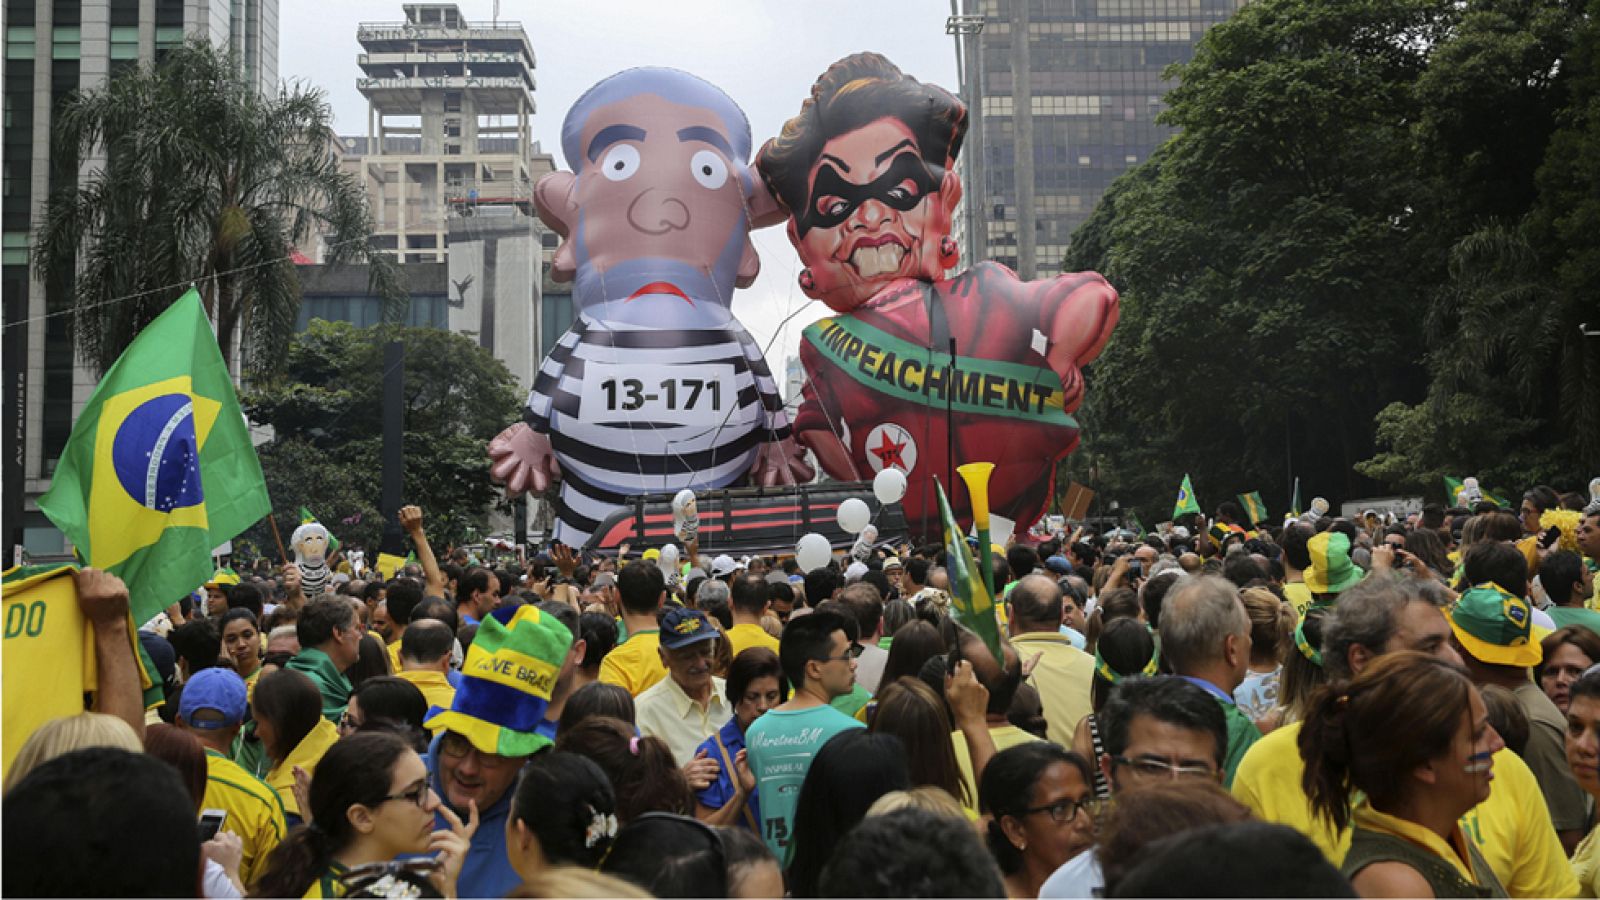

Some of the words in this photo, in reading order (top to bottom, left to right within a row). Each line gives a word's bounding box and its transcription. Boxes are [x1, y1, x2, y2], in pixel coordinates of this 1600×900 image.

[820, 322, 1053, 414] IMPEACHMENT
[16, 372, 24, 439] Paulista
[601, 378, 720, 410] 13-171
[16, 446, 23, 465] Av
[5, 600, 47, 639] DO
